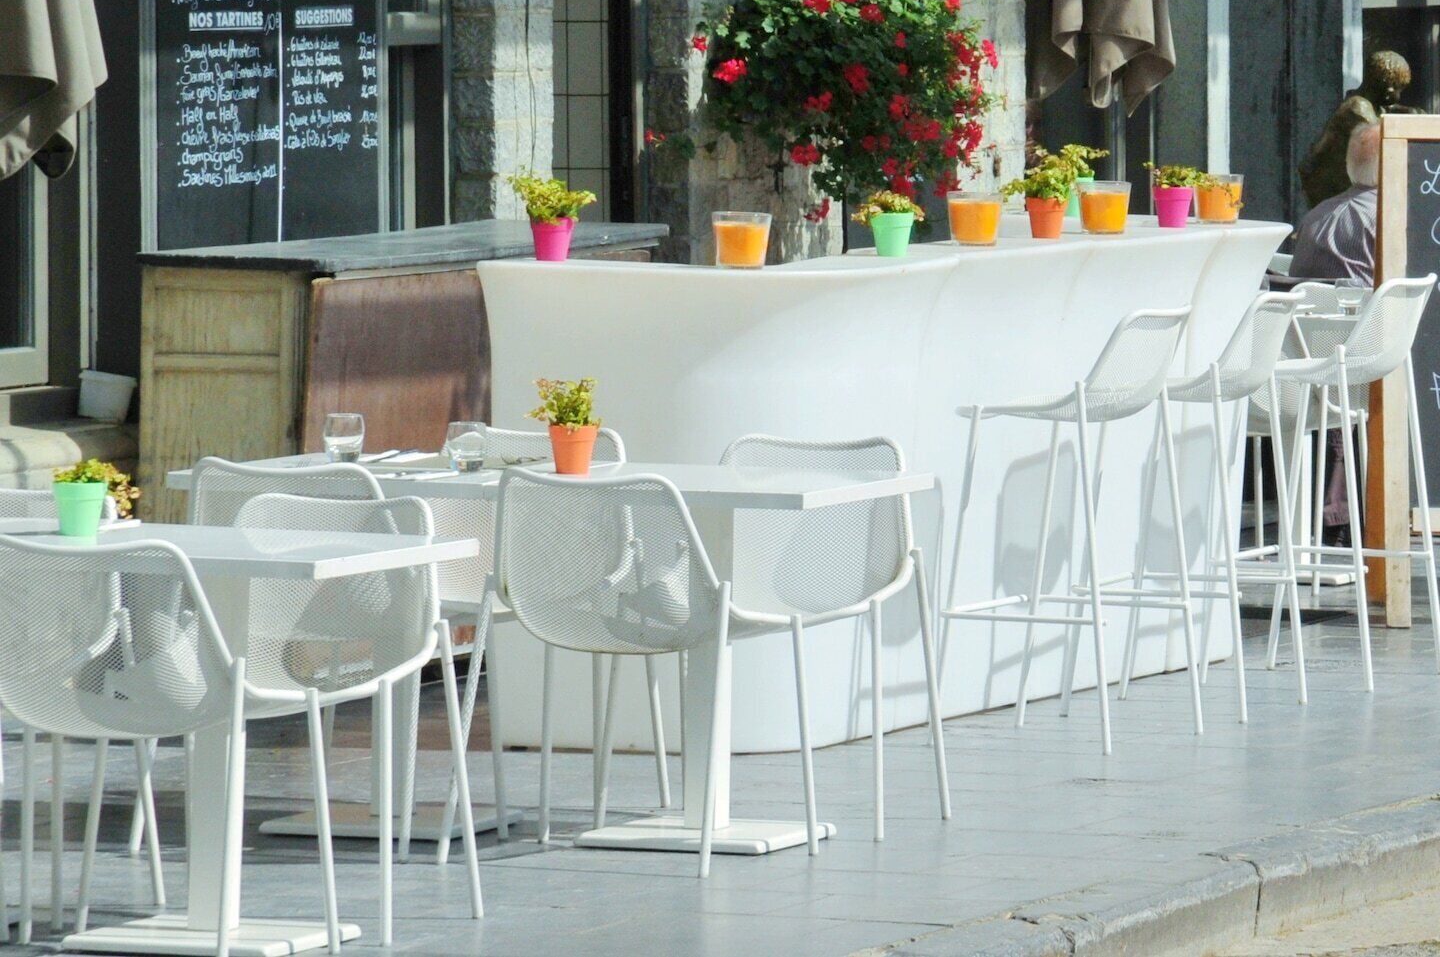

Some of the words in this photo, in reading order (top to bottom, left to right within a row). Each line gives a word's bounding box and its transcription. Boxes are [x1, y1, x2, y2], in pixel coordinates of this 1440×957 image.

[189, 12, 213, 28] NOS
[216, 11, 264, 27] TARTINES
[295, 8, 353, 25] SUGGESTIONS
